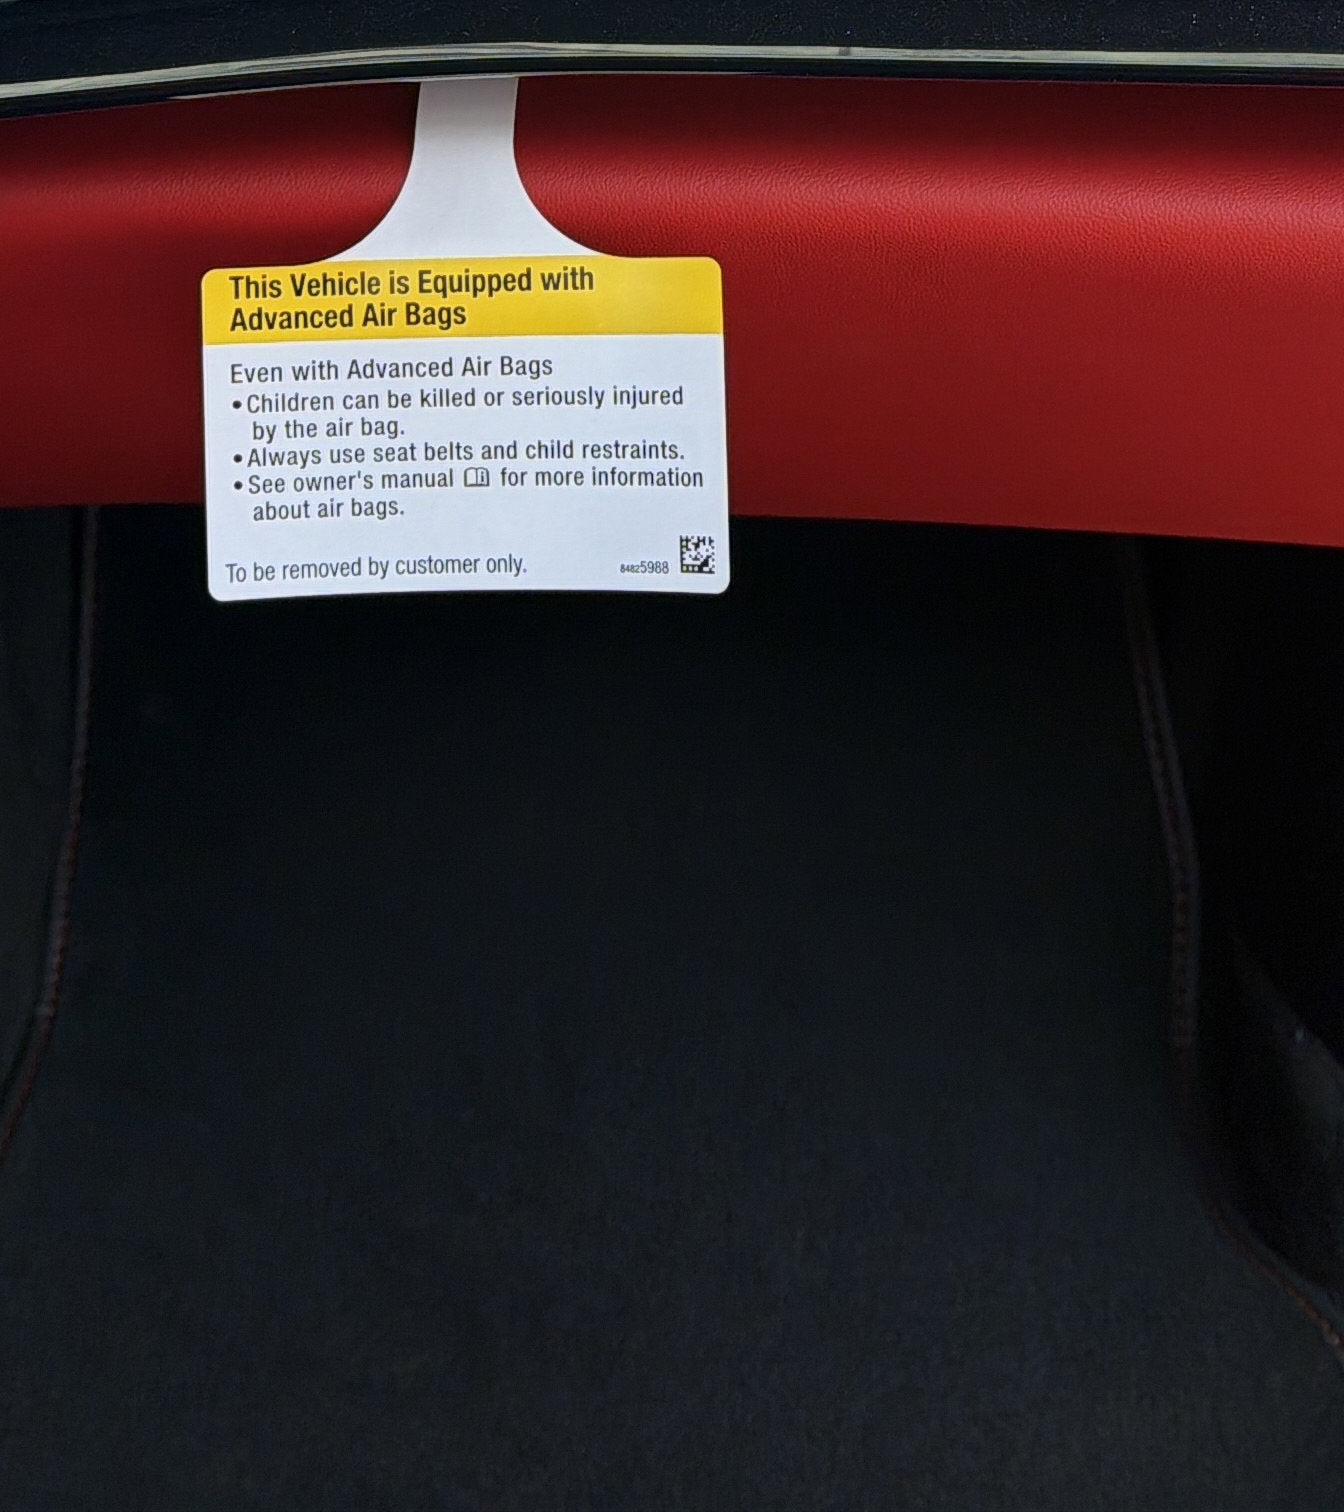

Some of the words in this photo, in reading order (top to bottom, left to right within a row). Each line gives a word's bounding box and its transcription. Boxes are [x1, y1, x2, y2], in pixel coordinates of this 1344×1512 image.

[228, 273, 283, 300] This
[289, 271, 381, 297] Vehicle
[388, 269, 410, 295] is
[418, 266, 532, 299] Equipped
[539, 265, 594, 291] with
[229, 303, 354, 332] Advanced
[361, 302, 398, 328] Air
[405, 301, 467, 331] Bags
[230, 363, 283, 384] Even
[291, 359, 339, 382] with
[346, 356, 454, 380] Advanced
[461, 355, 492, 377] Air
[500, 355, 553, 381] Bags
[246, 391, 335, 414] Children
[342, 393, 380, 410] can
[387, 389, 412, 409] be
[420, 387, 476, 408] killed
[483, 390, 505, 407] or
[512, 385, 605, 410] seriously
[612, 384, 684, 410] injured
[252, 420, 277, 445] by
[284, 419, 318, 439] the
[325, 416, 354, 438] air
[360, 416, 405, 440] bag.
[247, 446, 322, 470] Always
[329, 447, 366, 464] use
[373, 442, 417, 463] seat
[424, 441, 474, 462] belts
[481, 439, 518, 461] and
[525, 439, 574, 460] child
[582, 439, 685, 460] restraints.
[248, 474, 286, 495] See
[293, 470, 374, 493] owner's
[381, 467, 454, 489] manual
[500, 466, 528, 487] for
[535, 470, 585, 487] more
[591, 465, 704, 488] information
[253, 499, 311, 522] about
[317, 497, 345, 519] air
[351, 497, 405, 521] bags.
[224, 562, 247, 584] To
[253, 561, 276, 582] be
[282, 556, 362, 580] removed
[368, 556, 390, 580] by
[395, 554, 481, 576] customer
[486, 553, 527, 578] only.
